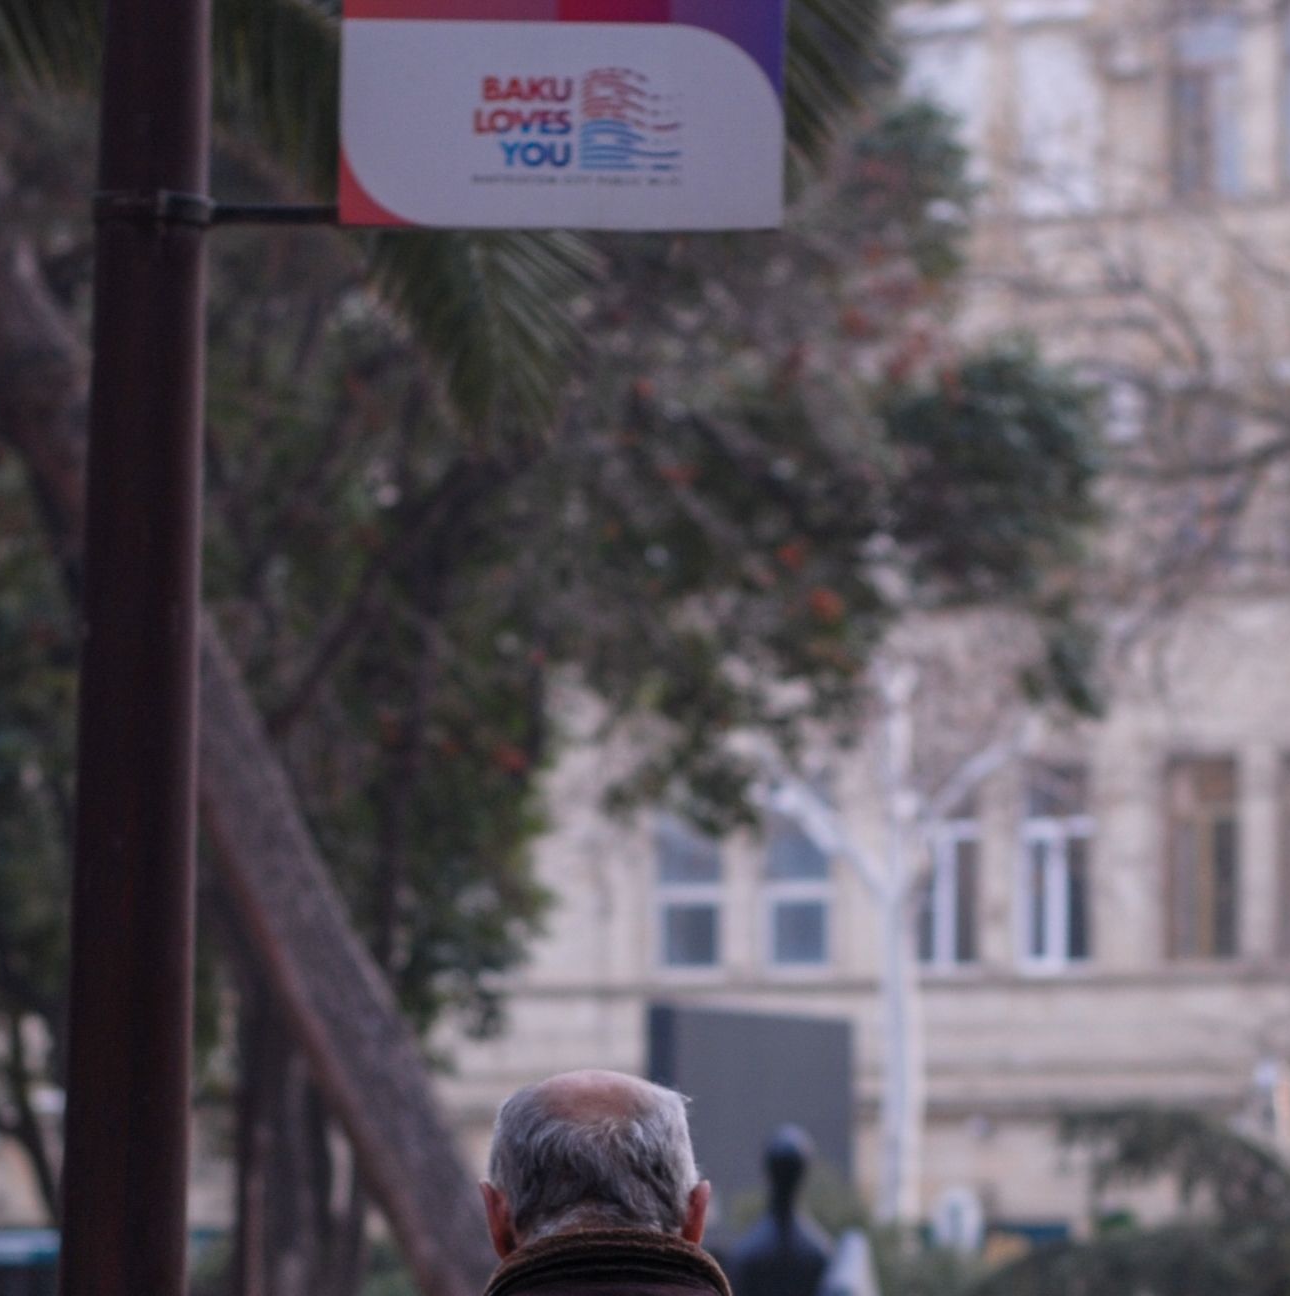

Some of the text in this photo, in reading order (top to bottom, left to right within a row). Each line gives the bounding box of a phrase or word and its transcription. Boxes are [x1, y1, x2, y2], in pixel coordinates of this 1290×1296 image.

[481, 75, 573, 102] BAKU
[473, 109, 572, 135] LOVES
[500, 141, 572, 168] YOU
